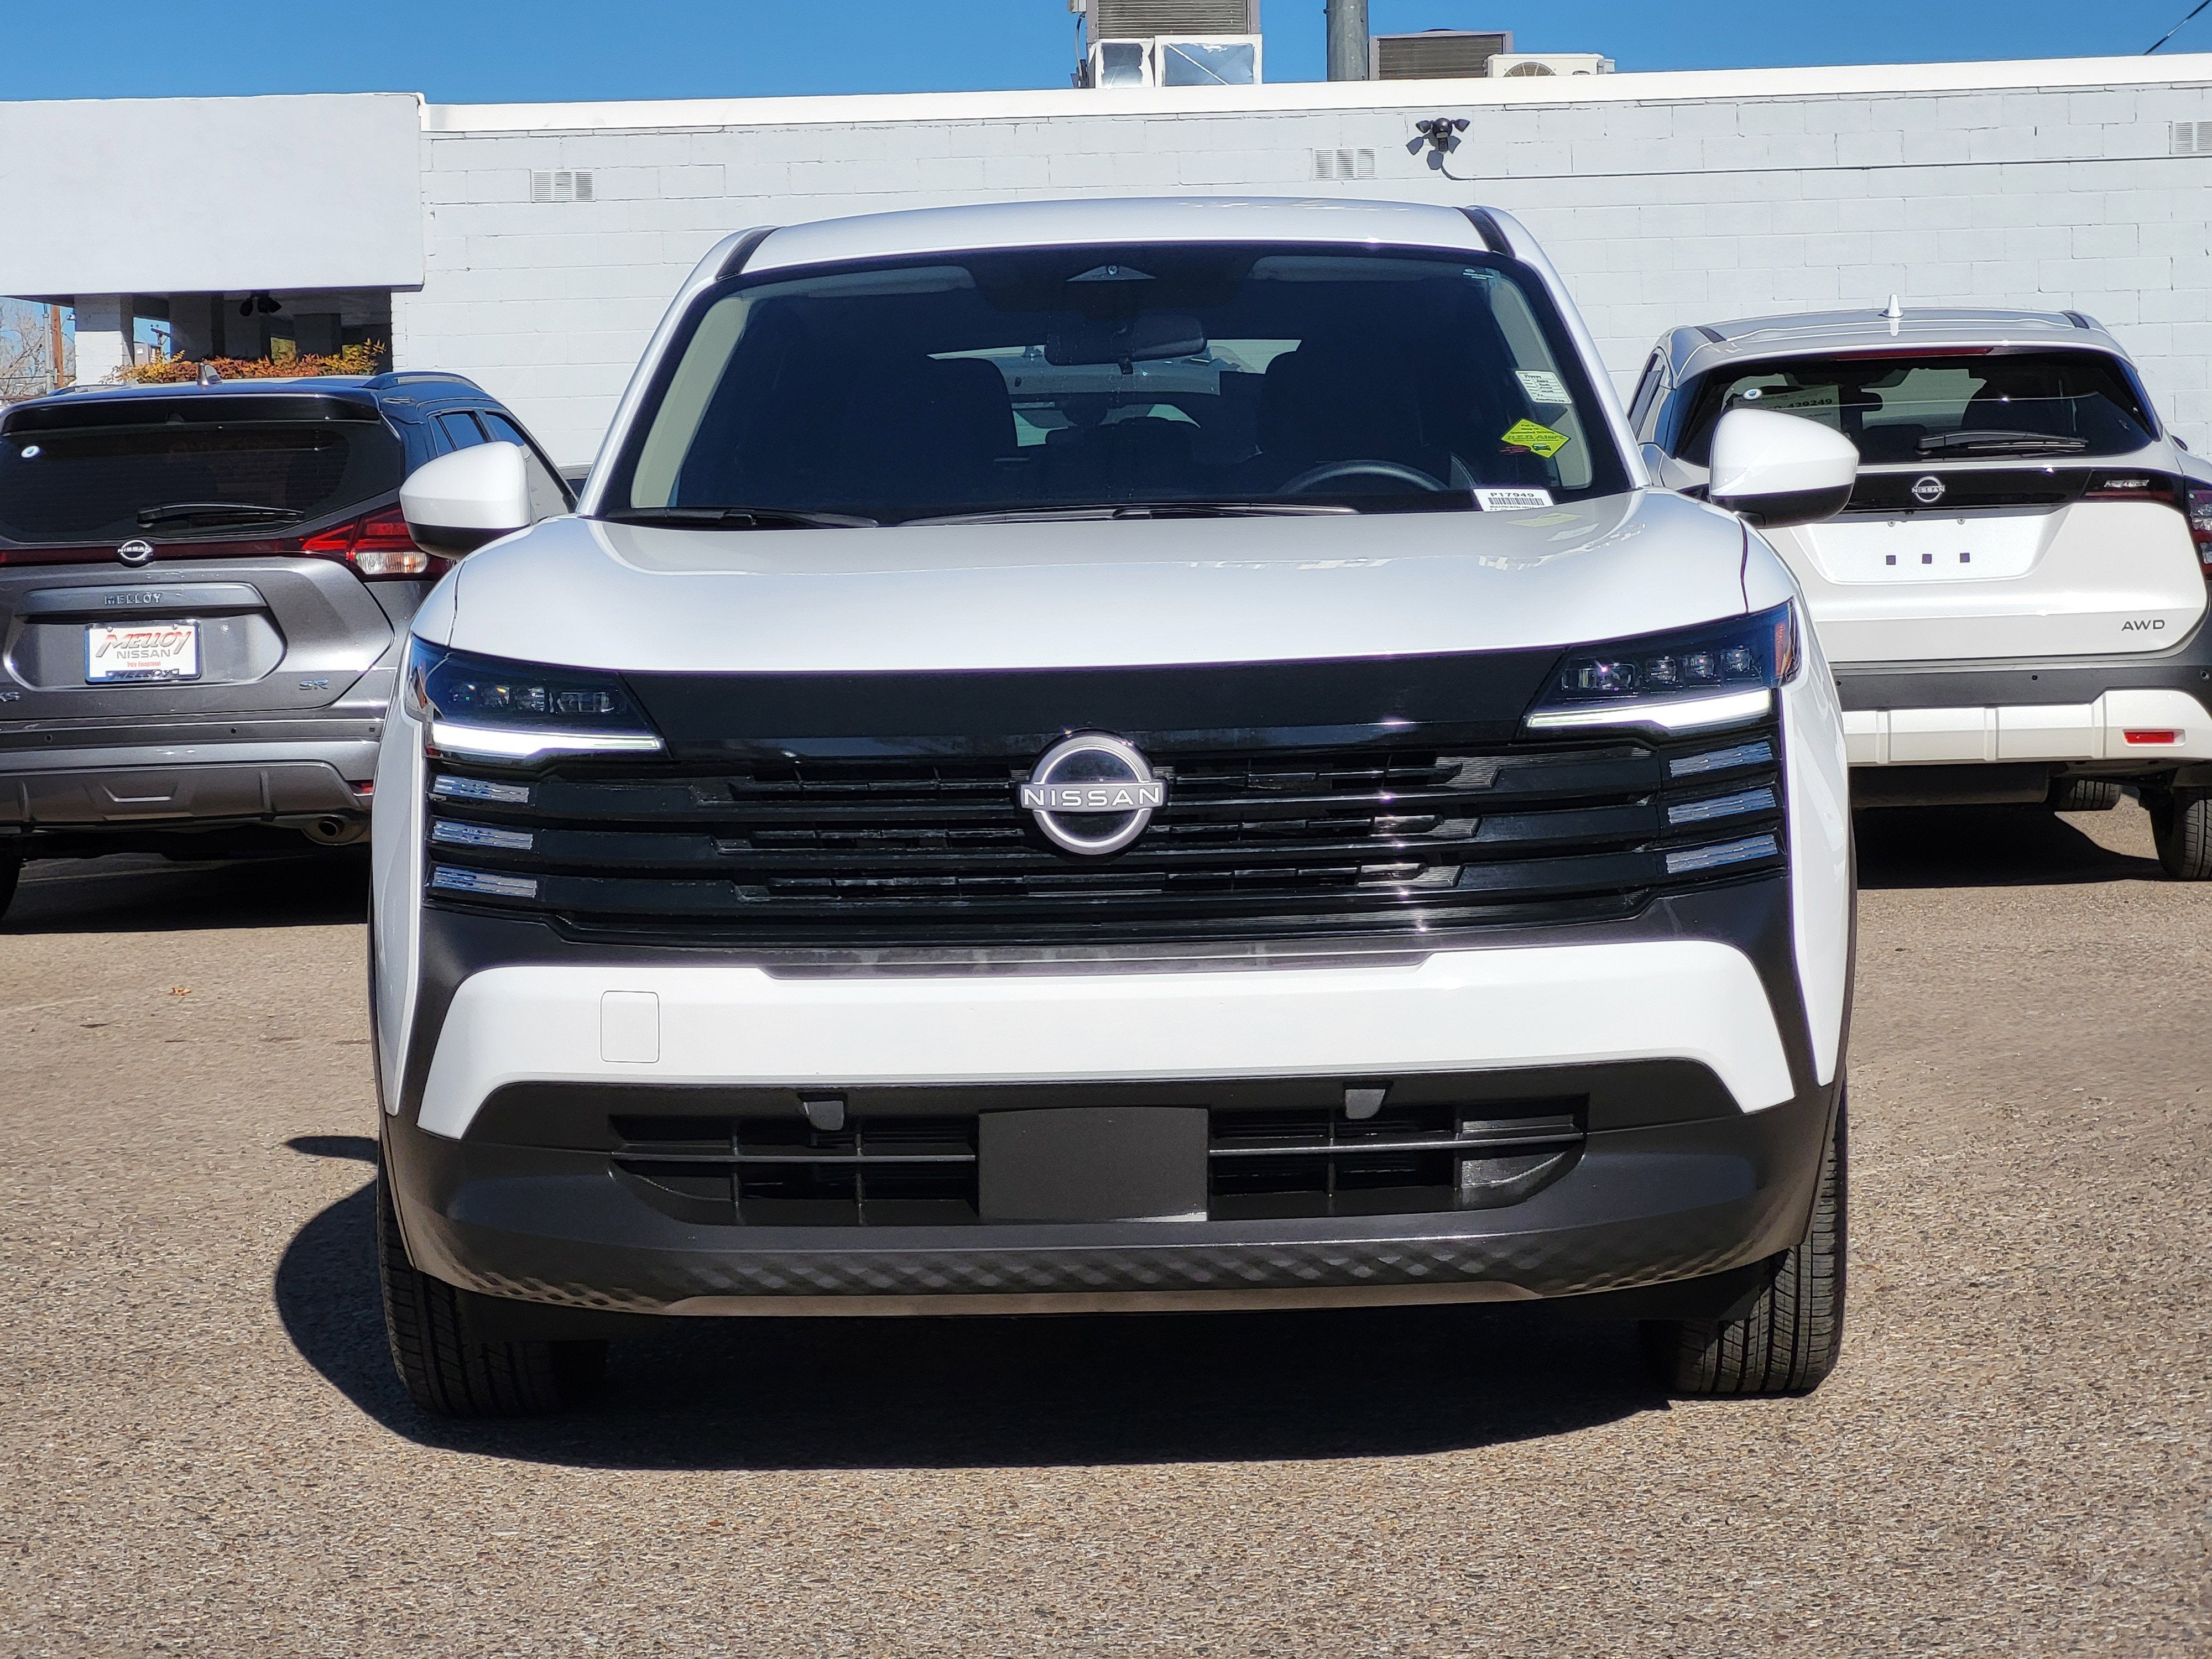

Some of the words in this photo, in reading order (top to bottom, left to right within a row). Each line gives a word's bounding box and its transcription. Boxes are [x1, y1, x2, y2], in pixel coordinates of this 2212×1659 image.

[1912, 484, 1945, 493] NISSAN
[104, 591, 162, 605] MELLOY
[2121, 619, 2166, 632] AWD
[96, 631, 192, 658] MELLOY
[117, 649, 171, 659] NISSAN
[299, 678, 330, 691] SR
[1024, 786, 1160, 807] NISSAN
